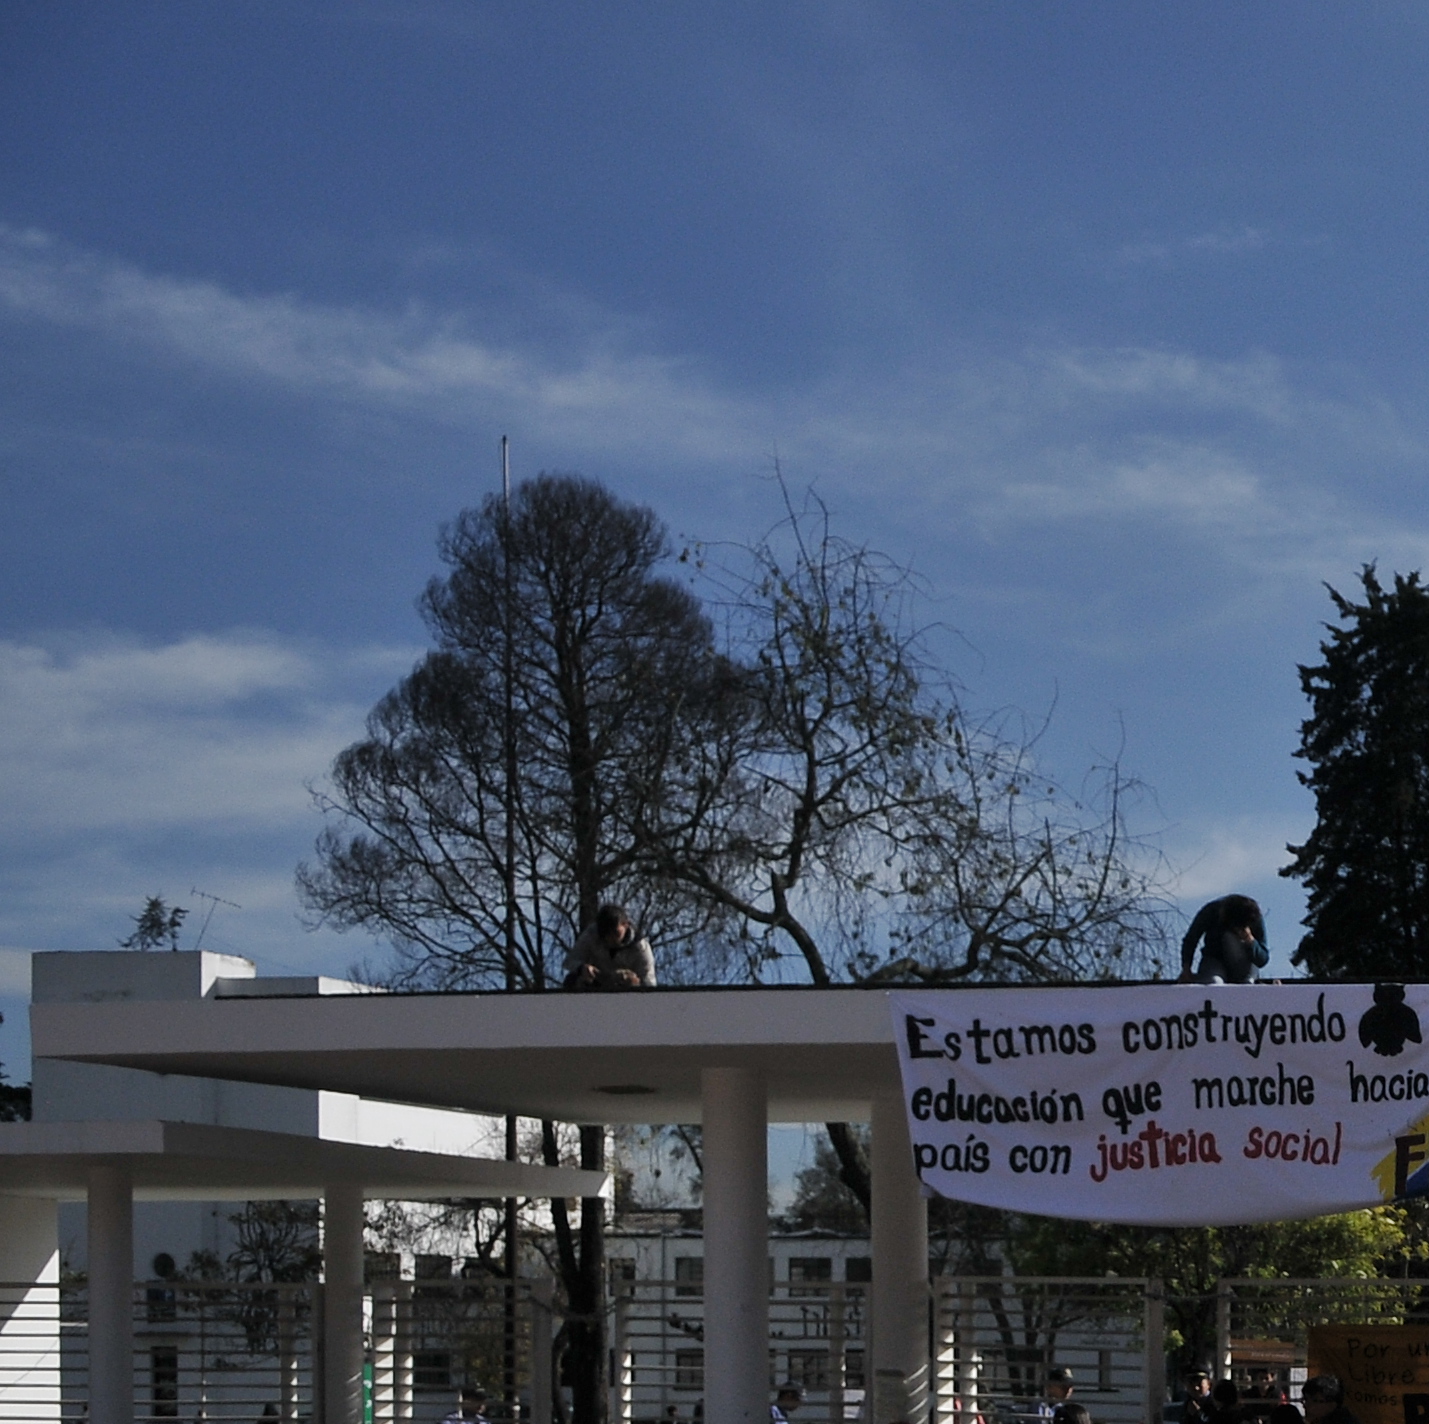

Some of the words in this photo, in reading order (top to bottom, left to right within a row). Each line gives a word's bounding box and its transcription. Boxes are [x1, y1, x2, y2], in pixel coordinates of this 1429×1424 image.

[905, 1014, 1097, 1066] Estamos
[1122, 992, 1347, 1058] construyendo
[911, 1078, 1086, 1125] educación
[1103, 1079, 1163, 1135] que
[1193, 1062, 1315, 1111] marche
[1346, 1060, 1429, 1103] hacia
[912, 1133, 991, 1180] país
[1008, 1143, 1072, 1175] con
[1089, 1121, 1223, 1183] justicia
[1243, 1122, 1344, 1167] social
[1347, 1337, 1390, 1358] Por
[1347, 1362, 1415, 1385] Libre
